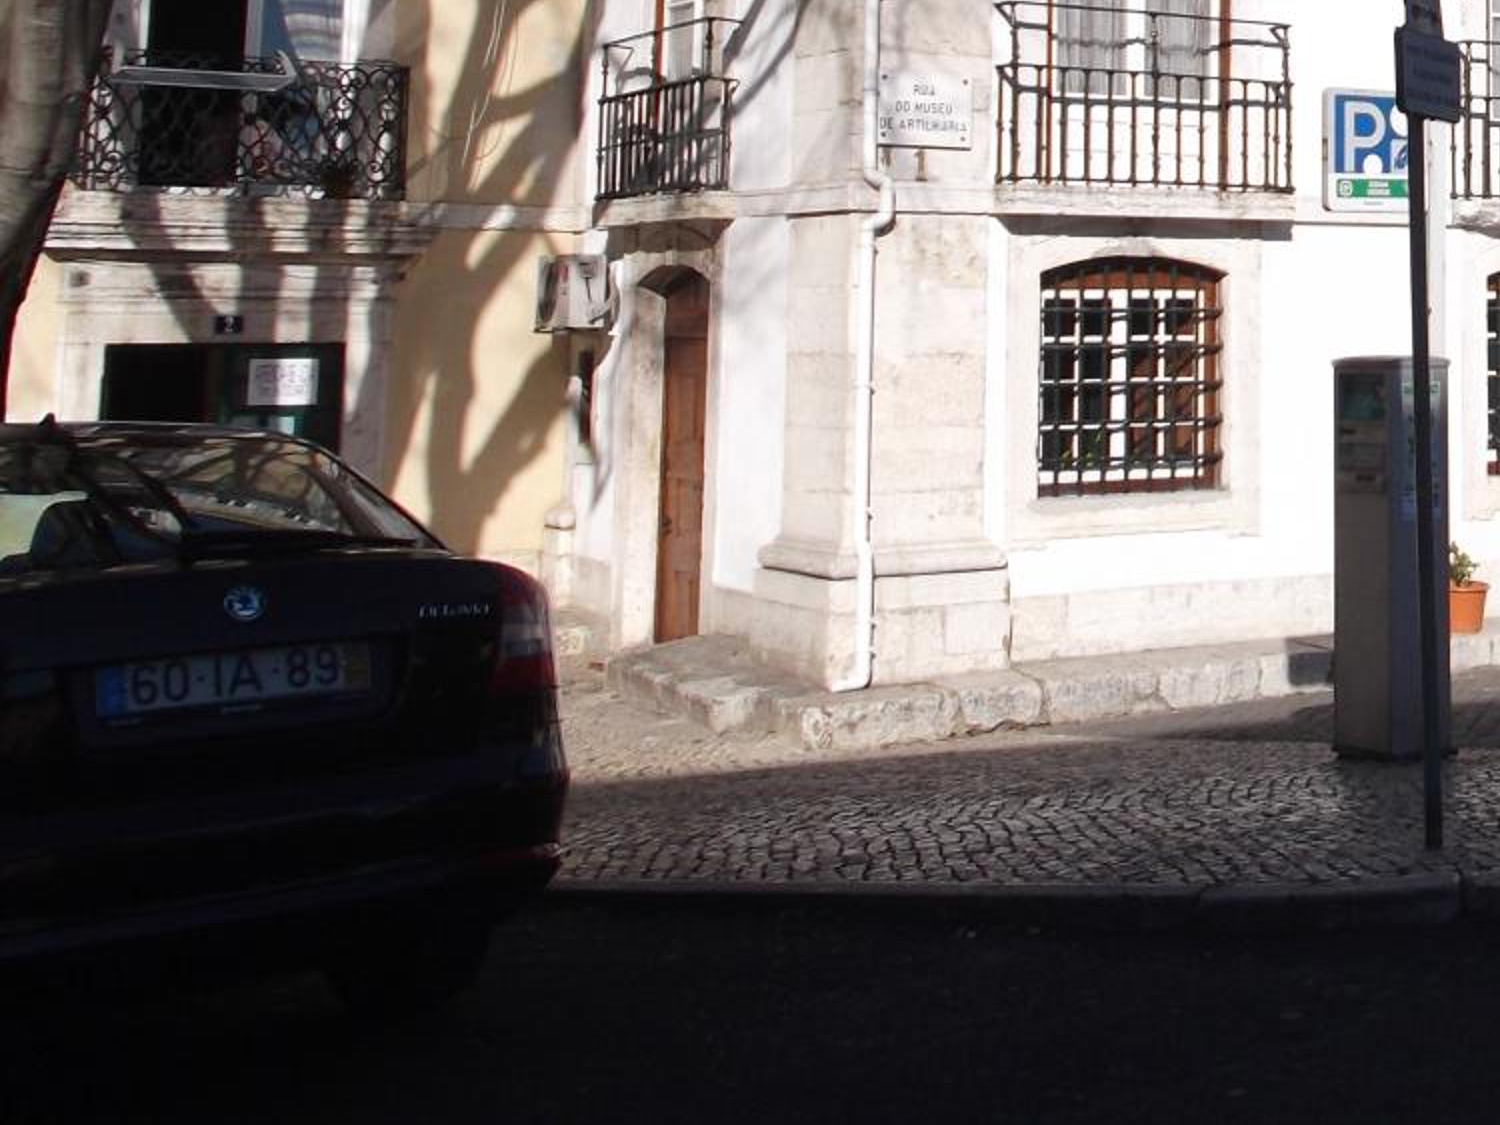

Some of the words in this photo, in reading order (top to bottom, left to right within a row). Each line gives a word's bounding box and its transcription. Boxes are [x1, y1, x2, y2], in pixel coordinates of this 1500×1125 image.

[895, 100, 911, 113] DO
[915, 102, 952, 114] MUSEU
[880, 117, 894, 130] DE
[1344, 100, 1386, 172] P
